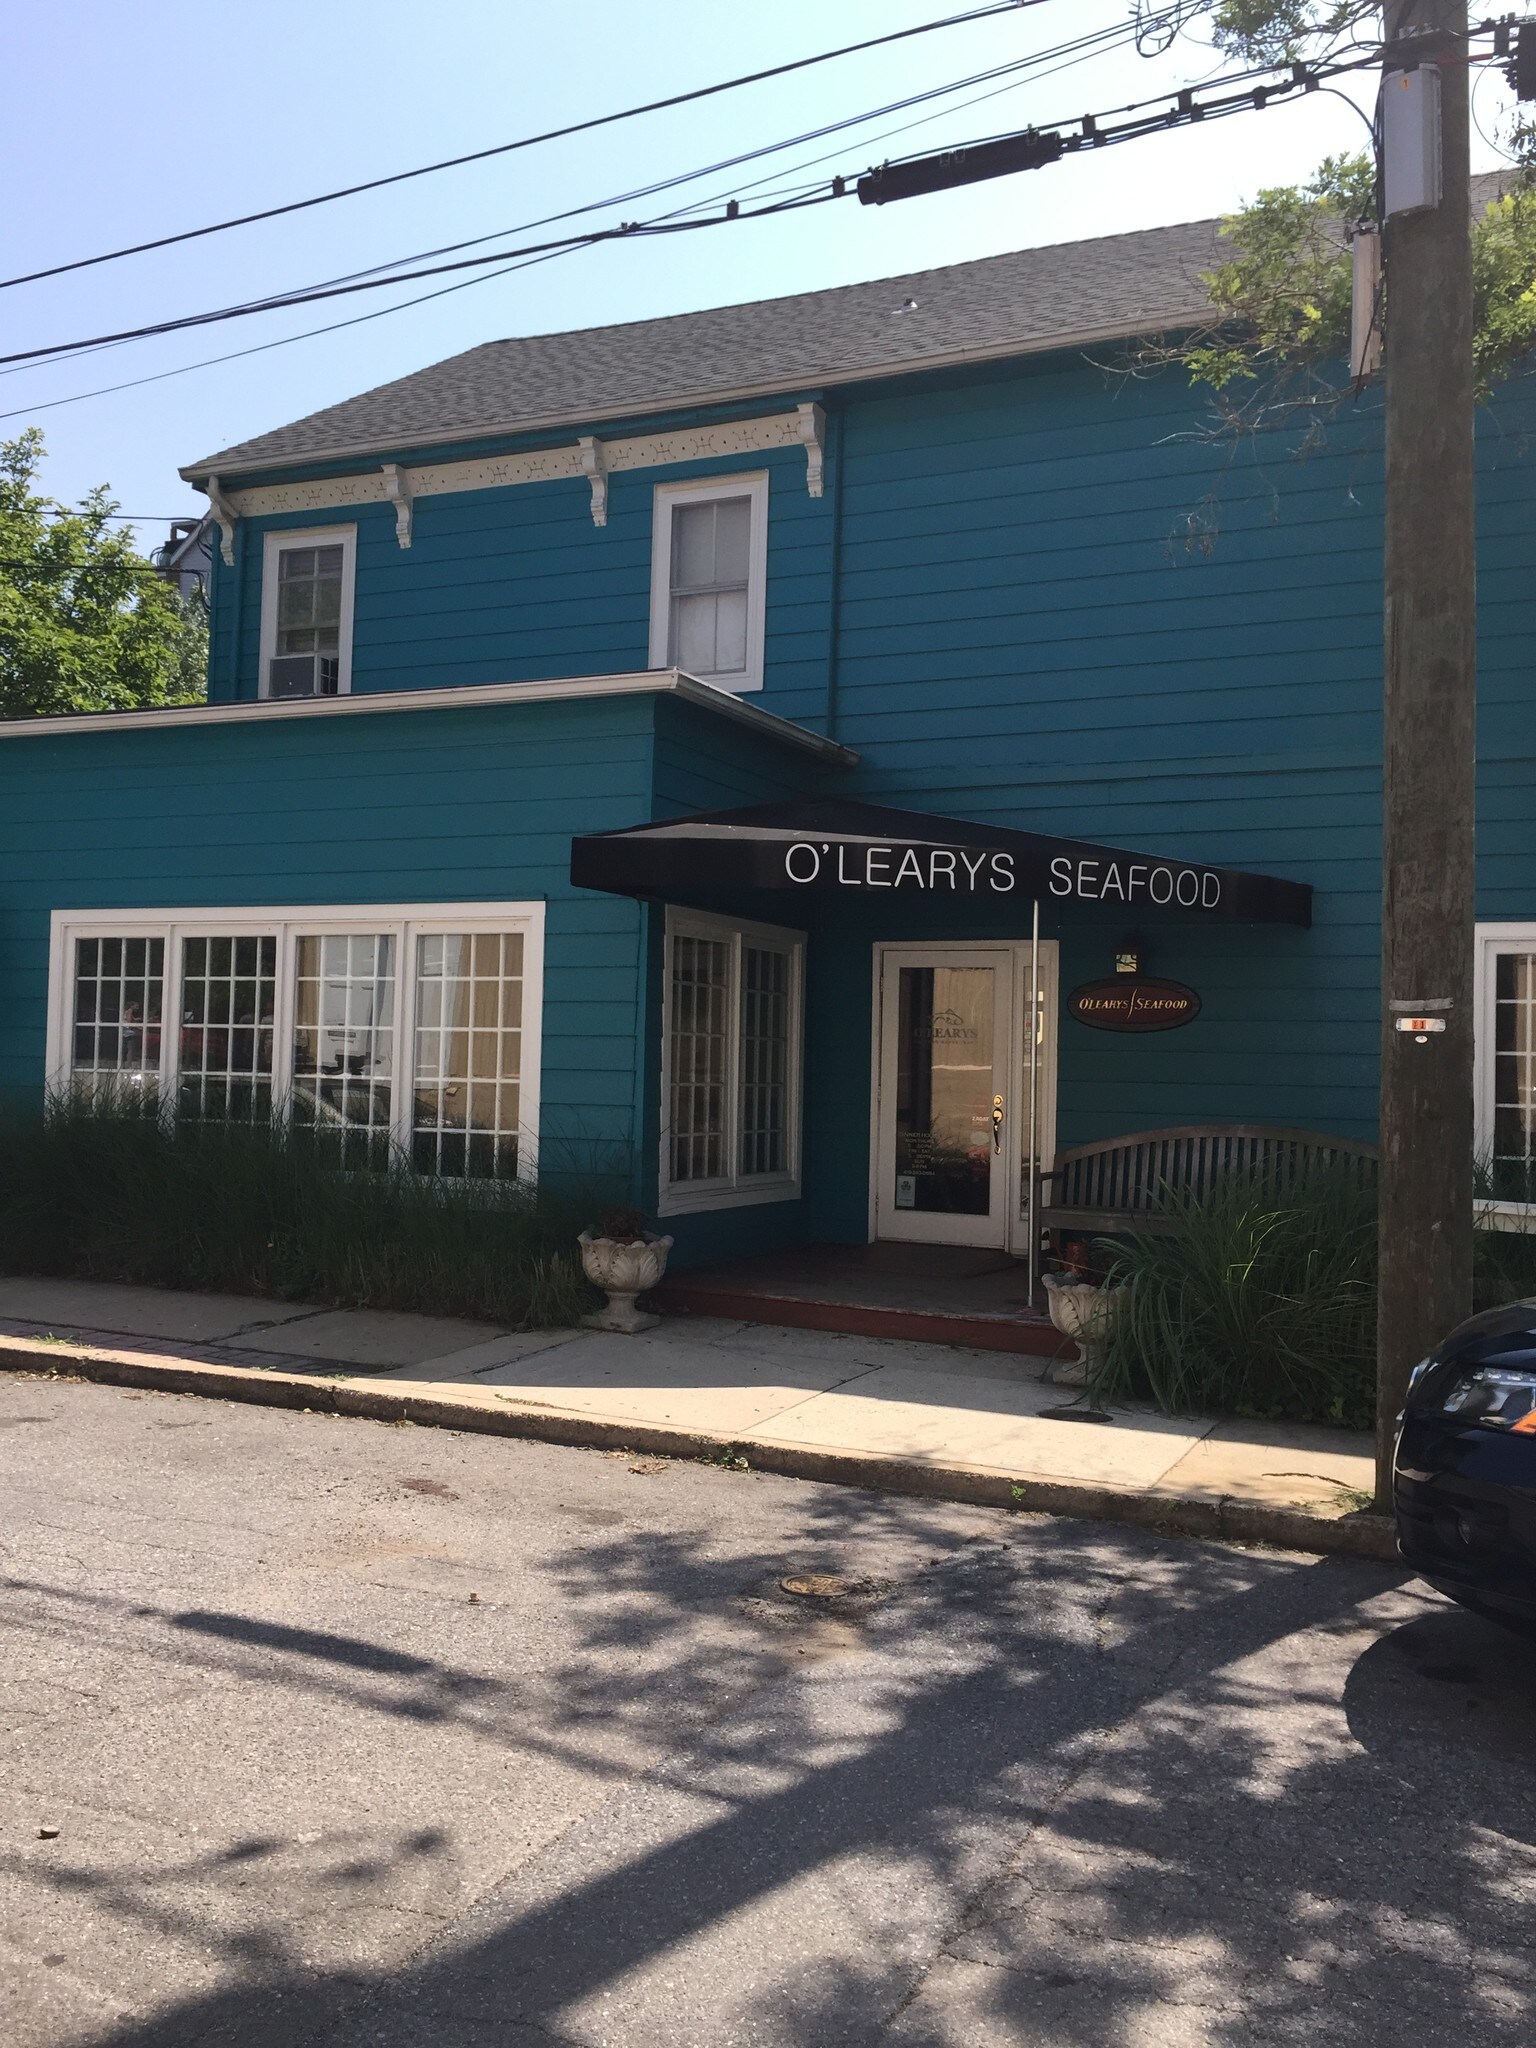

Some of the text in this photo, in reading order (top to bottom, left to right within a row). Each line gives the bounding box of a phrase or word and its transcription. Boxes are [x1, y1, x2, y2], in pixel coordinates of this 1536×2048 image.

[785, 843, 1221, 908] O'LEARYS SEAFOOD
[1079, 998, 1188, 1010] O'LEARYS SEAFOOD
